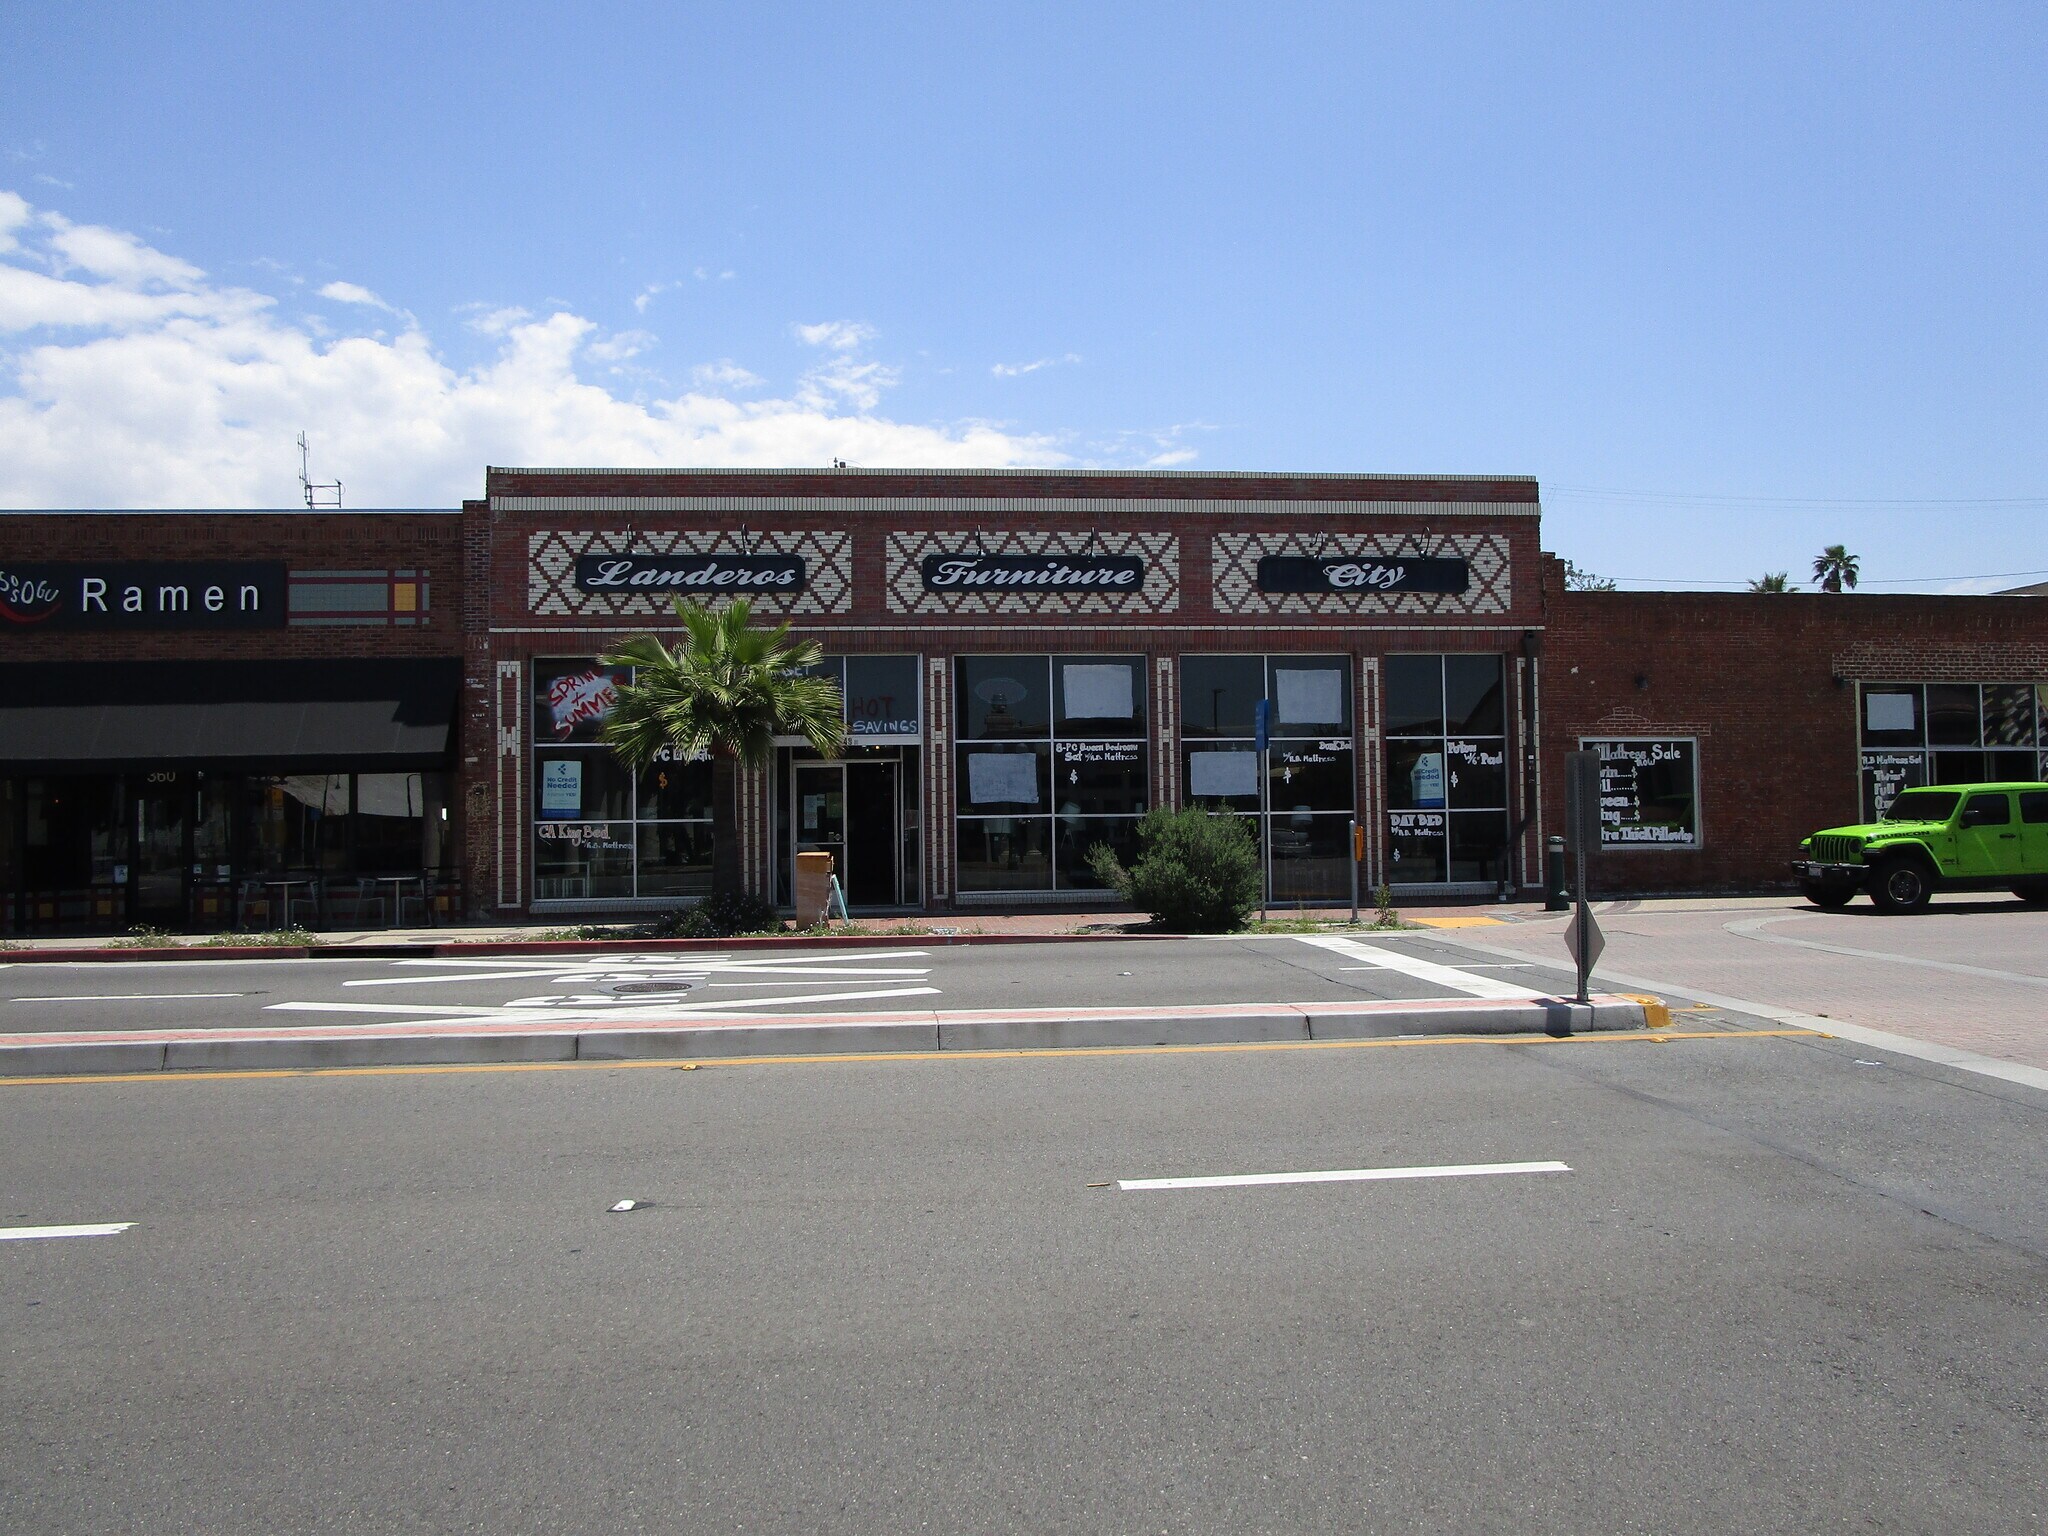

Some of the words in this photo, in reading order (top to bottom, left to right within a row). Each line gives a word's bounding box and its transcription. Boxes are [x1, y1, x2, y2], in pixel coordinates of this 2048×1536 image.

[586, 560, 796, 585] Landeros
[931, 560, 1136, 585] Furniture
[1323, 563, 1406, 589] City
[82, 577, 259, 612] Ramen
[852, 695, 895, 719] HOT
[852, 719, 918, 733] SAVINGS
[1480, 751, 1504, 765] Pad
[1651, 743, 1681, 761] Sale
[1069, 768, 1079, 784] $
[1450, 770, 1459, 788] $
[1874, 782, 1895, 796] Full
[1390, 814, 1417, 826] DAY
[558, 824, 583, 847] King
[1393, 848, 1401, 862] $
